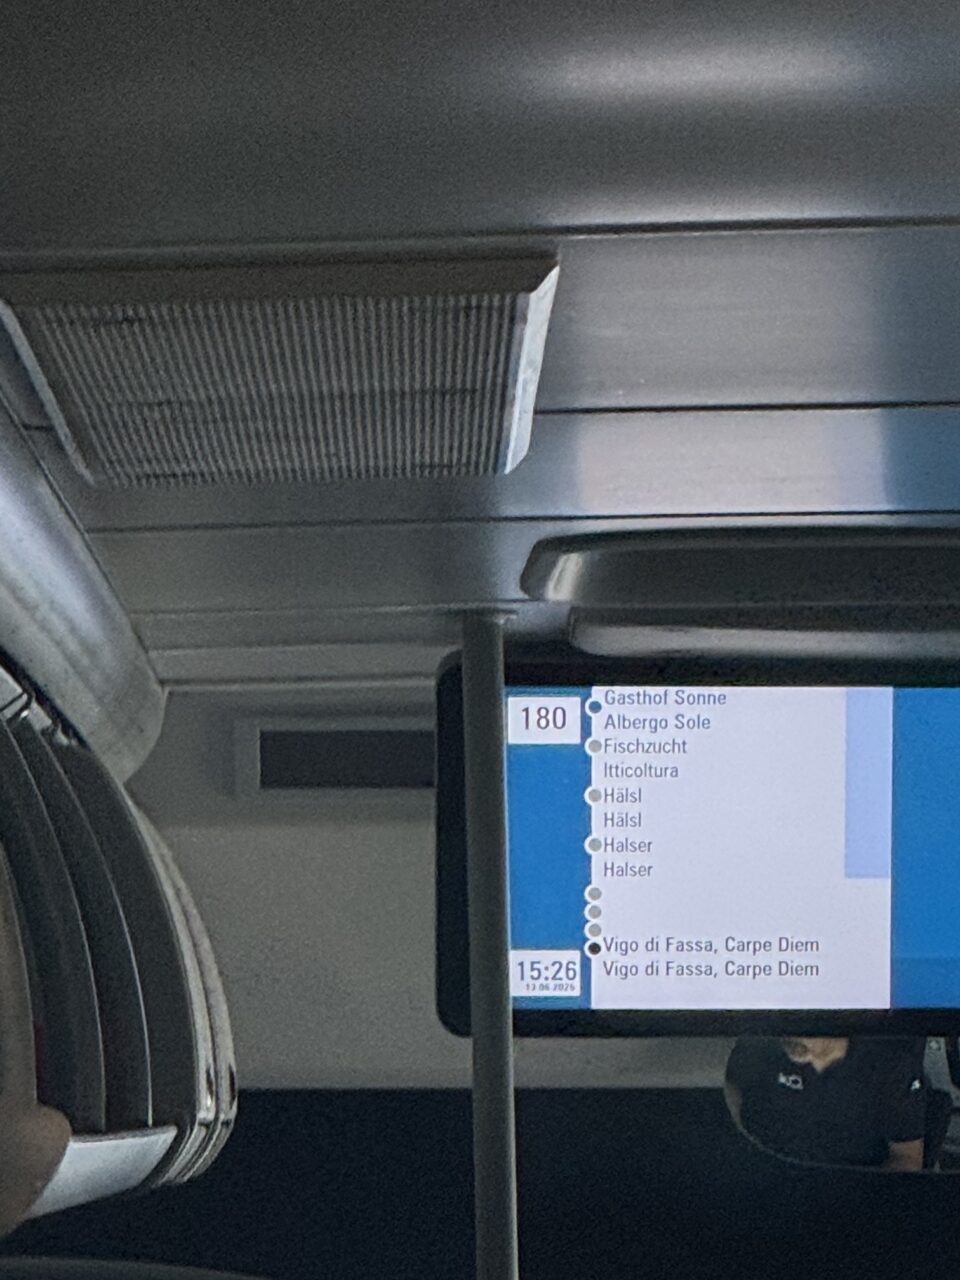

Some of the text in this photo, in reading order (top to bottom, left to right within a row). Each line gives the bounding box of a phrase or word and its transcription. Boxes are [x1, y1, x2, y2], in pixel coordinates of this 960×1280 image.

[605, 689, 726, 705] Gasthof Sonne
[522, 707, 566, 730] 180
[604, 714, 710, 733] Albergo Sole
[605, 738, 687, 754] Fischzucht
[604, 762, 678, 778] Itticoltura
[604, 787, 641, 803] Hälsl
[604, 812, 641, 828] Hälsl
[604, 837, 652, 852] Halser
[604, 862, 653, 877] Halser
[603, 937, 819, 956] Vigo di Fassa, Carpe Diem
[518, 961, 576, 981] 15:26
[603, 961, 819, 979] Vigo di Fassa, Carpe Diem
